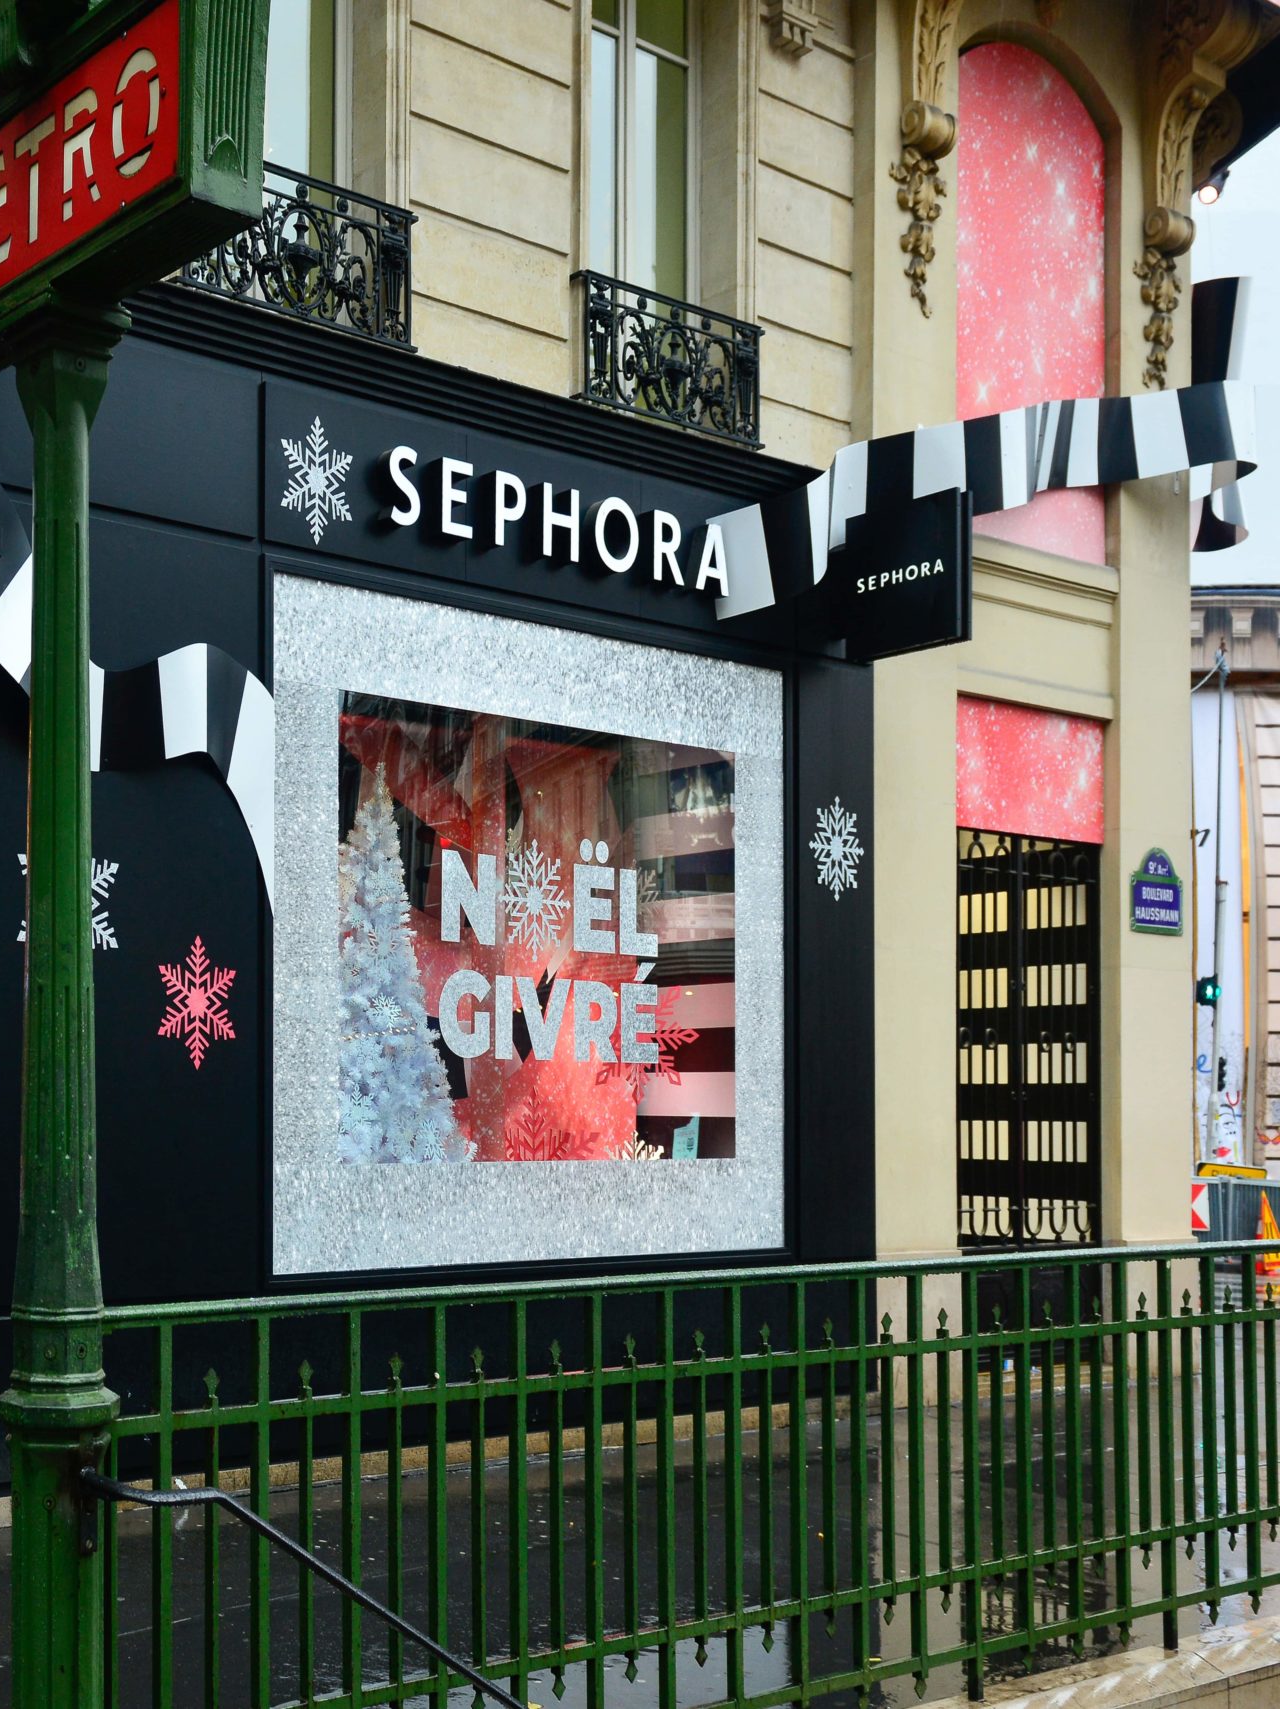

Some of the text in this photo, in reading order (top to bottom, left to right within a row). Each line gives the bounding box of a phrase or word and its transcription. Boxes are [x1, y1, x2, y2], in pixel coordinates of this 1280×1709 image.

[388, 445, 729, 597] SEPHORA
[856, 558, 944, 594] SEPHORA
[440, 838, 659, 959] NËL
[1135, 906, 1180, 922] HAUSSMANN
[1142, 886, 1174, 902] BOULEVARD
[438, 963, 659, 1064] GIVRÉ
